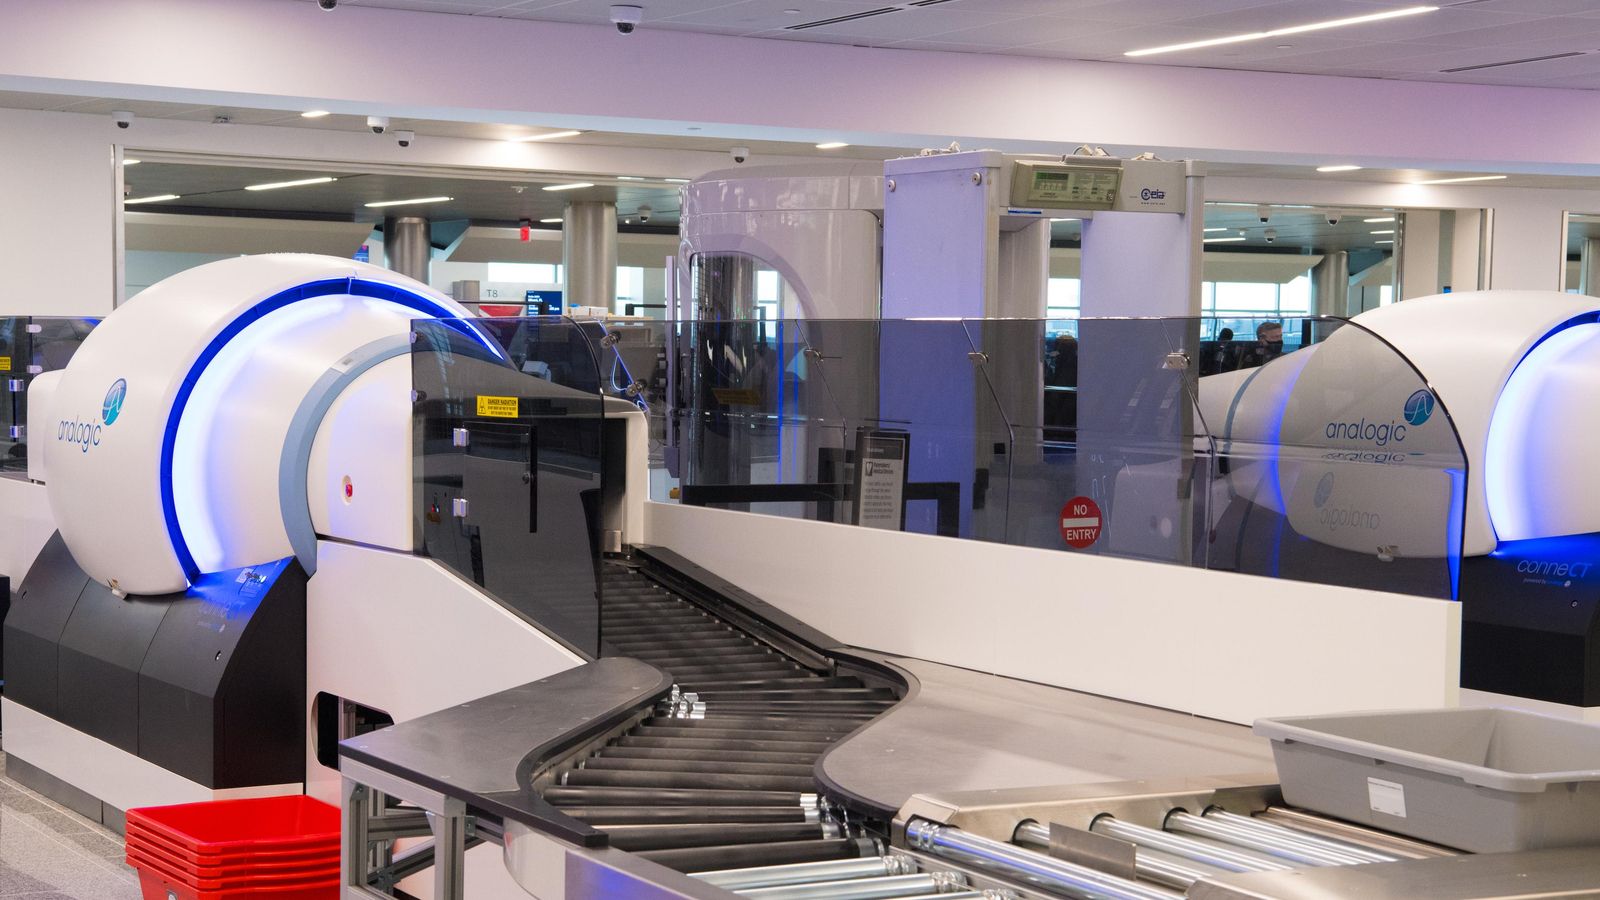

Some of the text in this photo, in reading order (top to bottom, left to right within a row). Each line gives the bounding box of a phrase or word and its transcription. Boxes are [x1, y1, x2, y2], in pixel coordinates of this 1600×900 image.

[486, 289, 498, 298] T8
[58, 414, 102, 453] analogic
[1326, 417, 1407, 447] analogic
[1073, 504, 1088, 516] NO
[1066, 528, 1097, 541] ENTRY
[1517, 559, 1593, 578] conneCT
